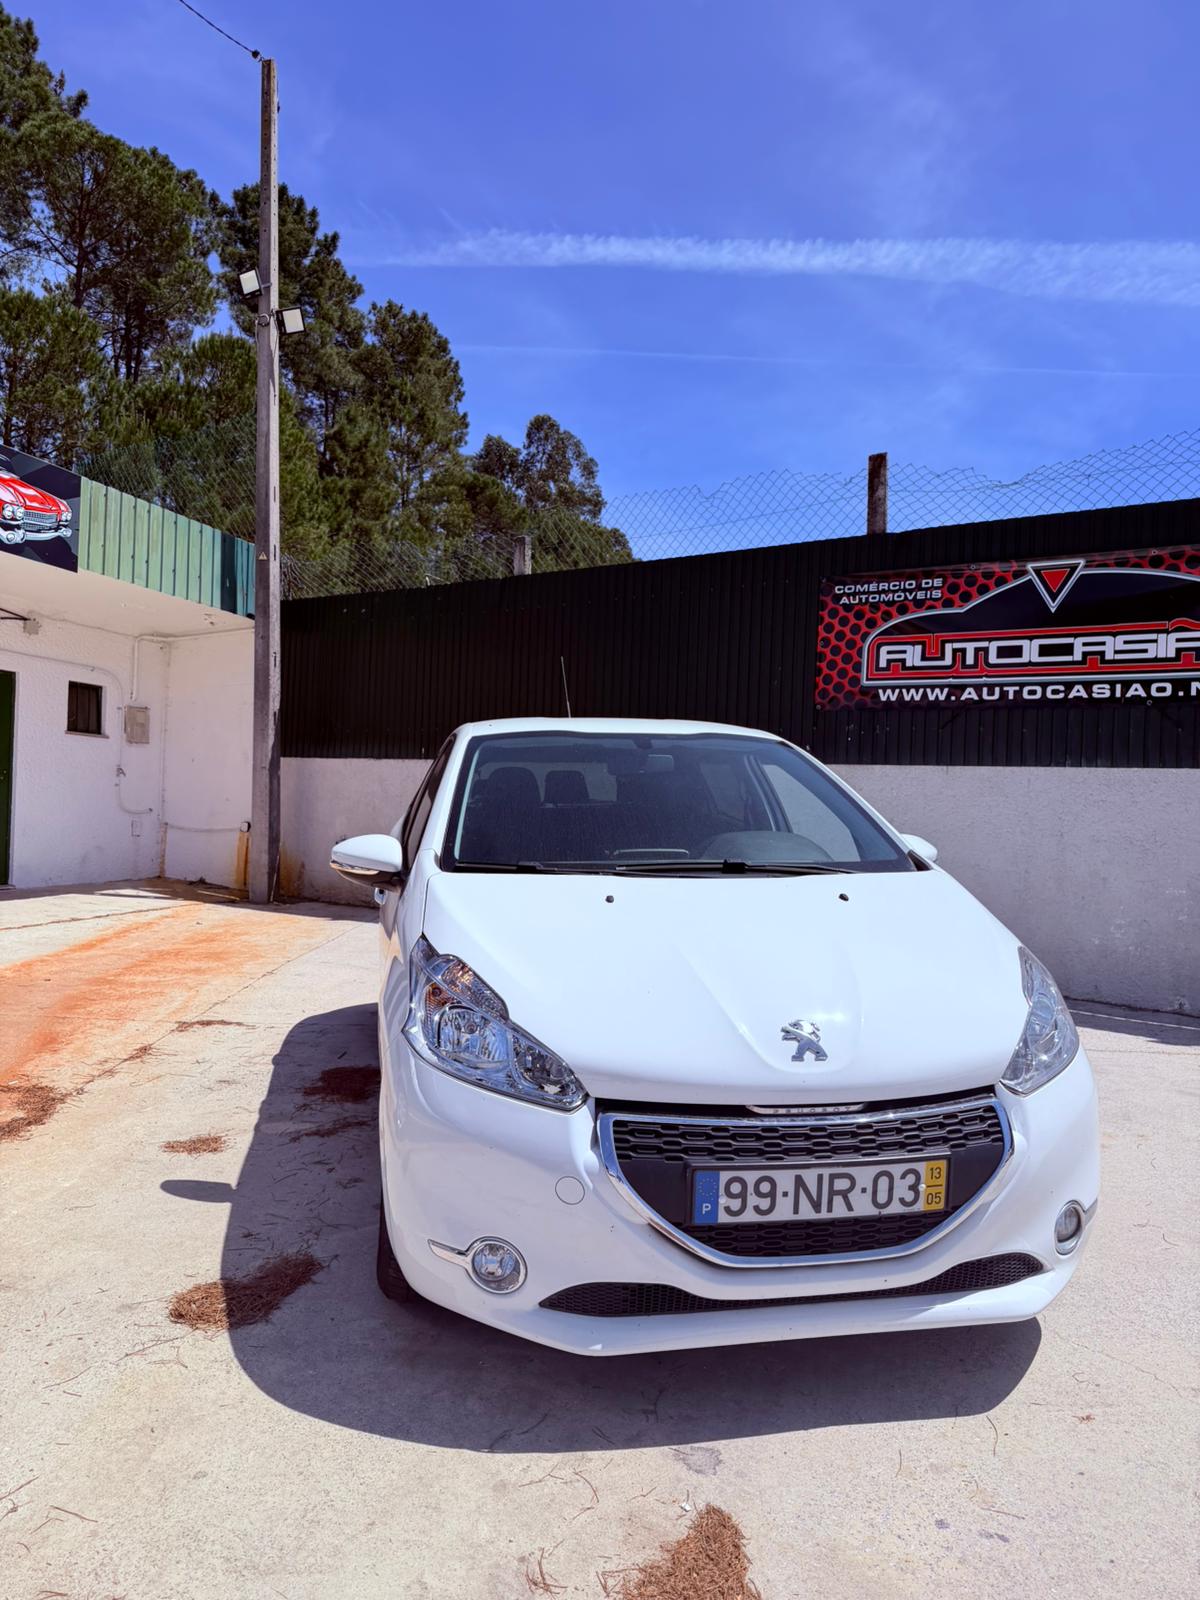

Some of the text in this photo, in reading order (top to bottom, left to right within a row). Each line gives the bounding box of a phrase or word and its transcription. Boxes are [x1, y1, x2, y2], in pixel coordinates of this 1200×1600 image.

[834, 578, 944, 594] COMÉRCIO DE
[839, 590, 942, 605] AUTOMÓVEIS
[929, 1166, 942, 1180] 13
[926, 1192, 942, 1205] 05
[702, 1203, 711, 1214] P
